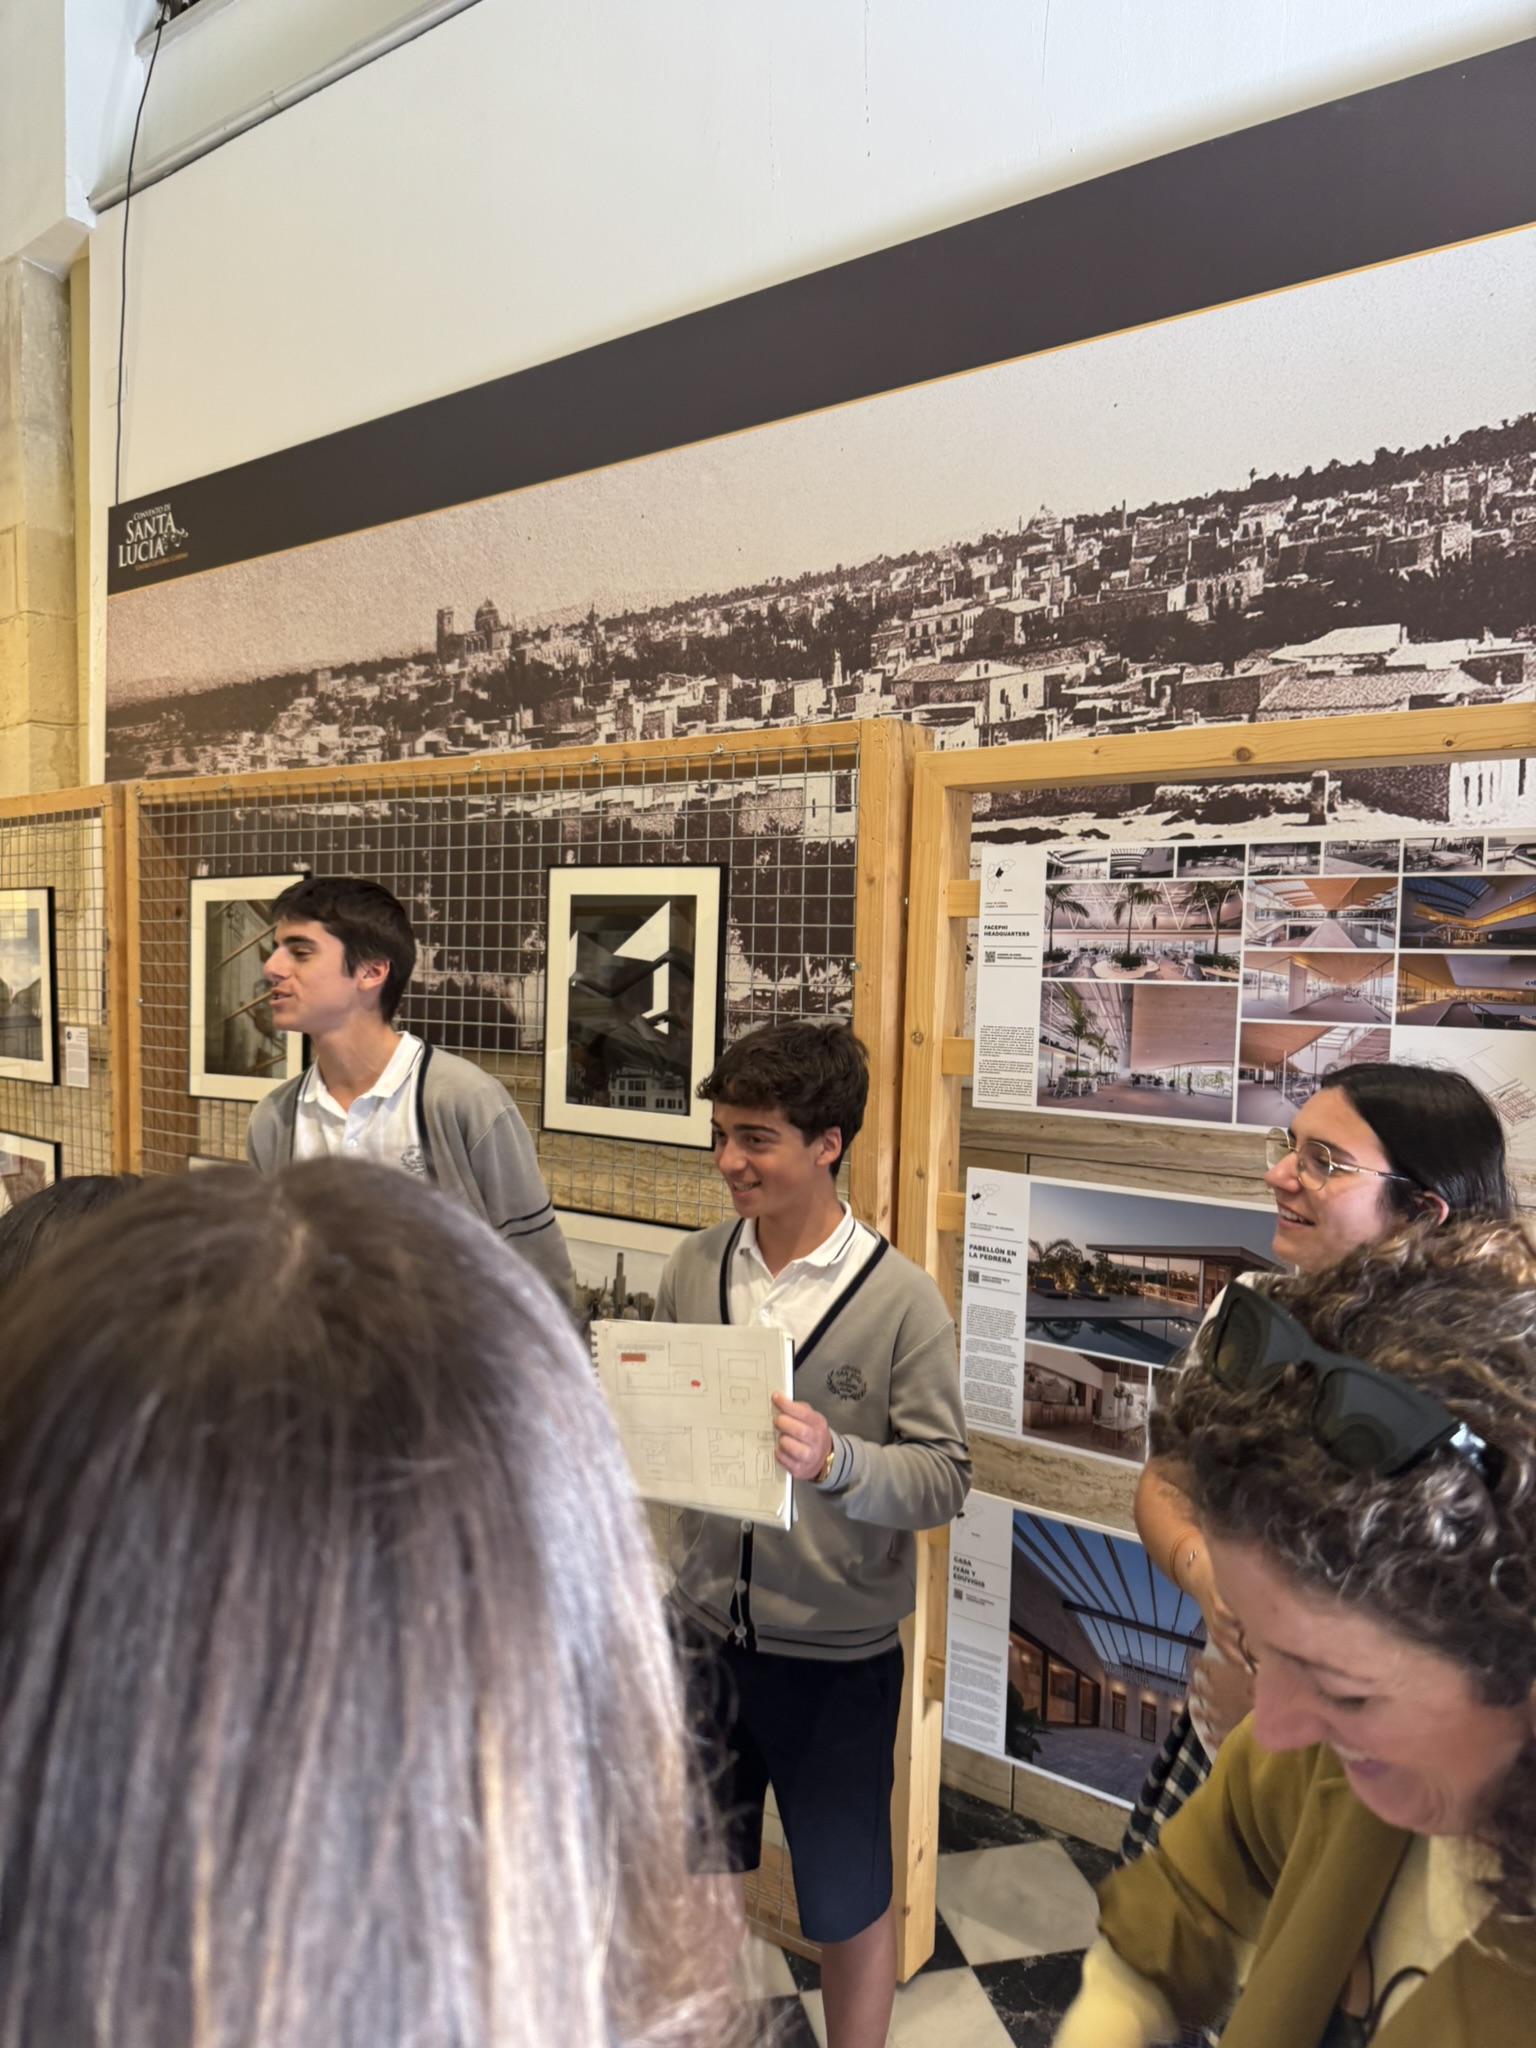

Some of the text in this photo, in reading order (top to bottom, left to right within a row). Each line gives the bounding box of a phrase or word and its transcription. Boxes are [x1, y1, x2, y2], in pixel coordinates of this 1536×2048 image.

[126, 511, 176, 544] SANTA
[969, 1244, 1017, 1257] PABELLÓN EN
[969, 1251, 1012, 1264] LA PEDRERA
